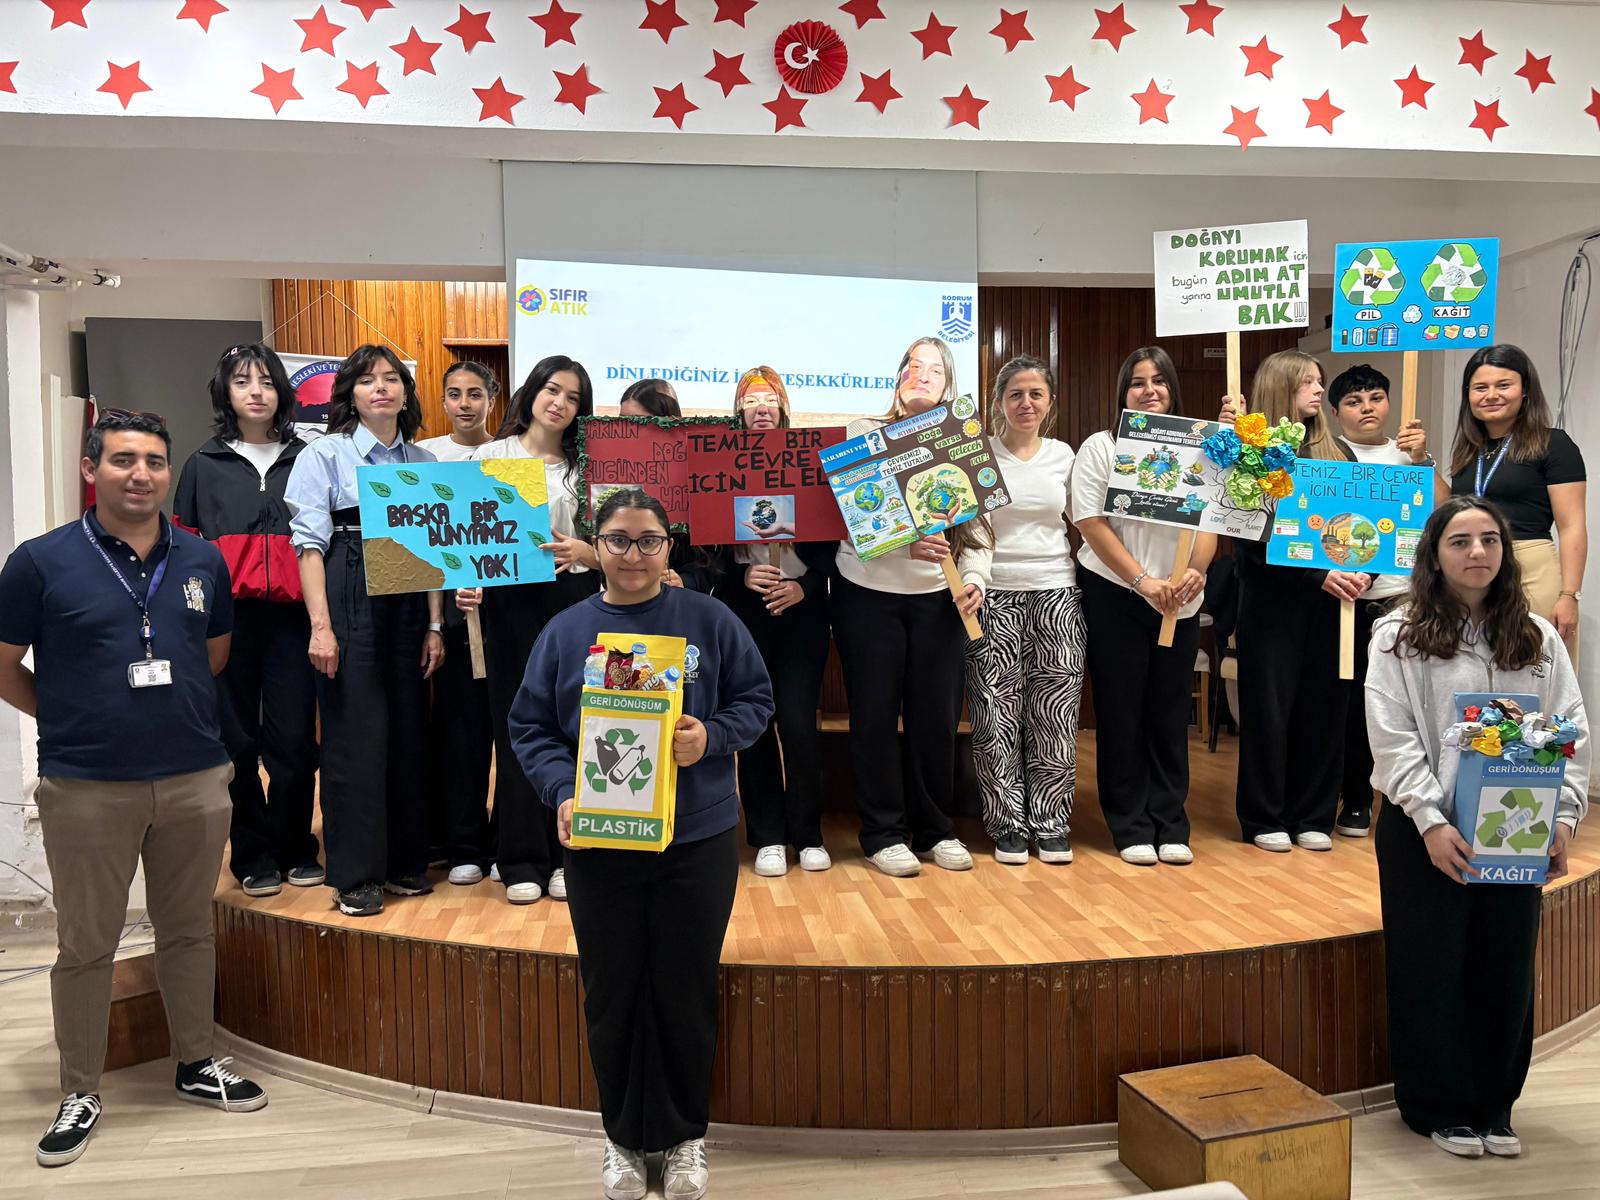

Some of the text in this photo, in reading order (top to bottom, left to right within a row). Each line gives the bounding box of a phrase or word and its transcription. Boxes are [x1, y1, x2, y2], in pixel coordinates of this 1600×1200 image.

[1171, 229, 1241, 249] DOĞAYI
[1200, 246, 1289, 267] KORUMAK
[1172, 264, 1305, 289] bugün ADIM AT
[549, 288, 588, 302] SIFIR
[1217, 283, 1301, 301] UMUTLA
[550, 301, 588, 316] ATIK
[1433, 306, 1470, 317] KAĞIT
[606, 364, 729, 383] DİNLEDİĞİNİZ
[688, 428, 823, 453] TEMİZ BİR
[936, 434, 961, 448] varsa
[653, 441, 687, 462] DOĞ
[735, 450, 811, 471] ÇEVRE
[887, 449, 921, 466] ÇEVREMİZİ
[949, 442, 982, 461] gelecek
[882, 453, 932, 476] TEMİZ TUTALIM!
[1296, 462, 1341, 480] TEMİZ
[1383, 466, 1425, 485] ÇEVRE
[765, 470, 795, 489] EL
[801, 467, 829, 487] EL
[1310, 481, 1401, 502] İÇİN EL ELE
[470, 497, 499, 523] BİR
[1210, 515, 1226, 524] LOVE
[1226, 526, 1241, 534] OUR
[589, 695, 662, 711] GERİ DÖNÜŞÜM
[1488, 764, 1560, 775] GERİ DÖNÜŞÜM
[578, 818, 656, 837] PLASTİK
[1479, 864, 1538, 881] KAĞIT
